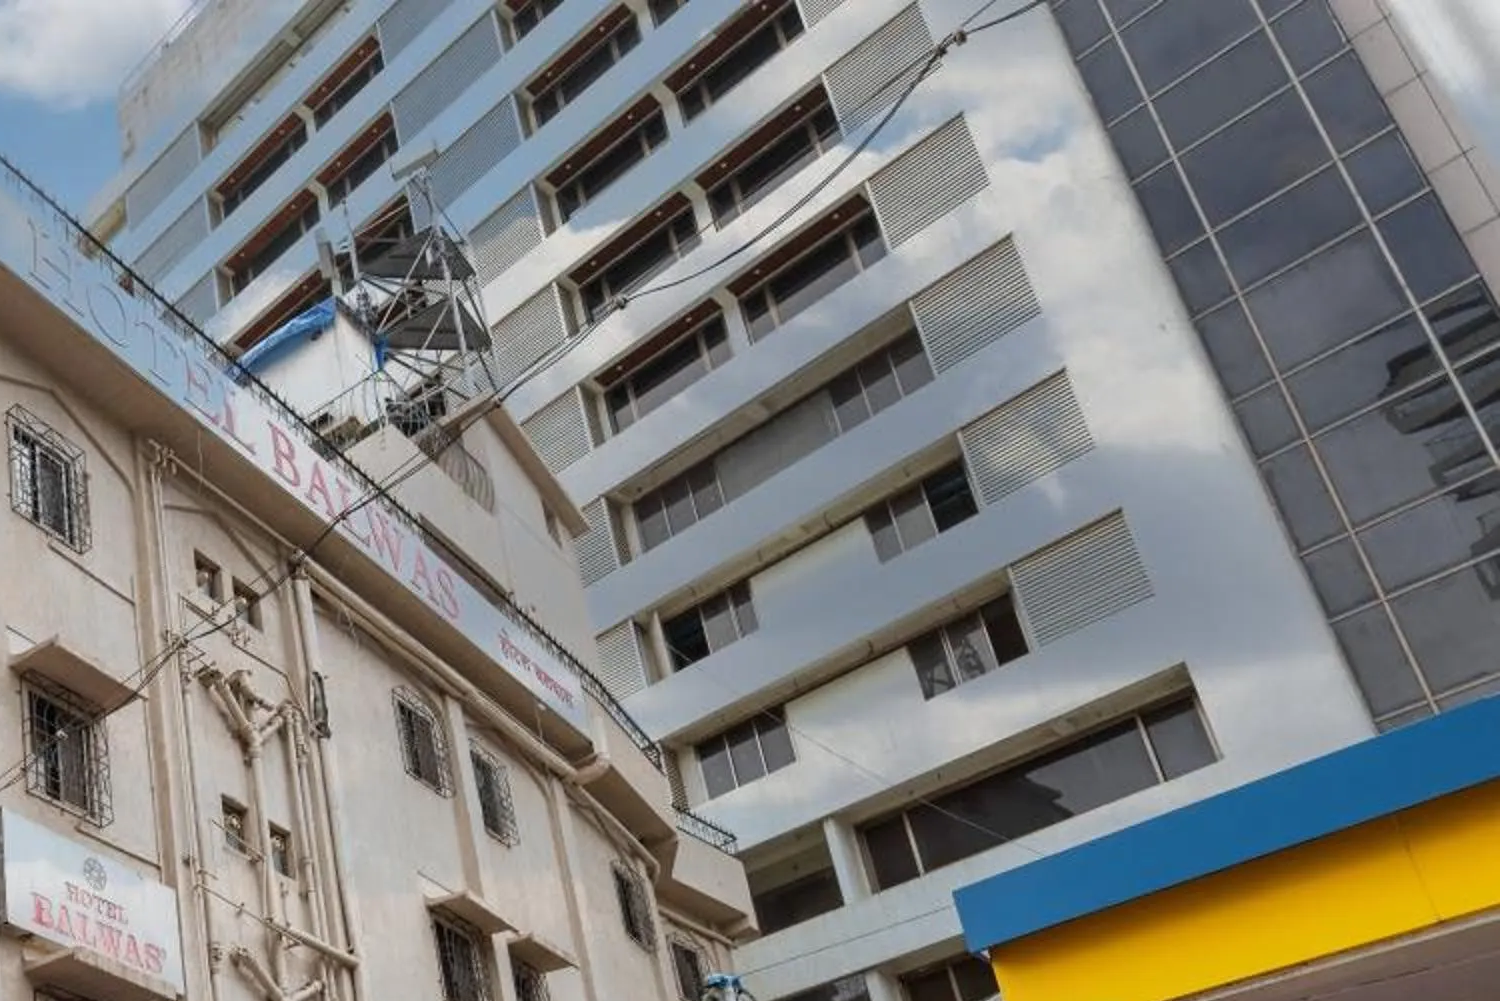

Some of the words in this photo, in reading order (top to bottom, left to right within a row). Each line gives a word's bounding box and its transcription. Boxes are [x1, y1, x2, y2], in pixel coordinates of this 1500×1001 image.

[26, 216, 257, 456] HOTEL
[267, 419, 460, 620] BALWAS
[31, 891, 168, 974] BALWAS
[64, 881, 129, 925] HOTEL
